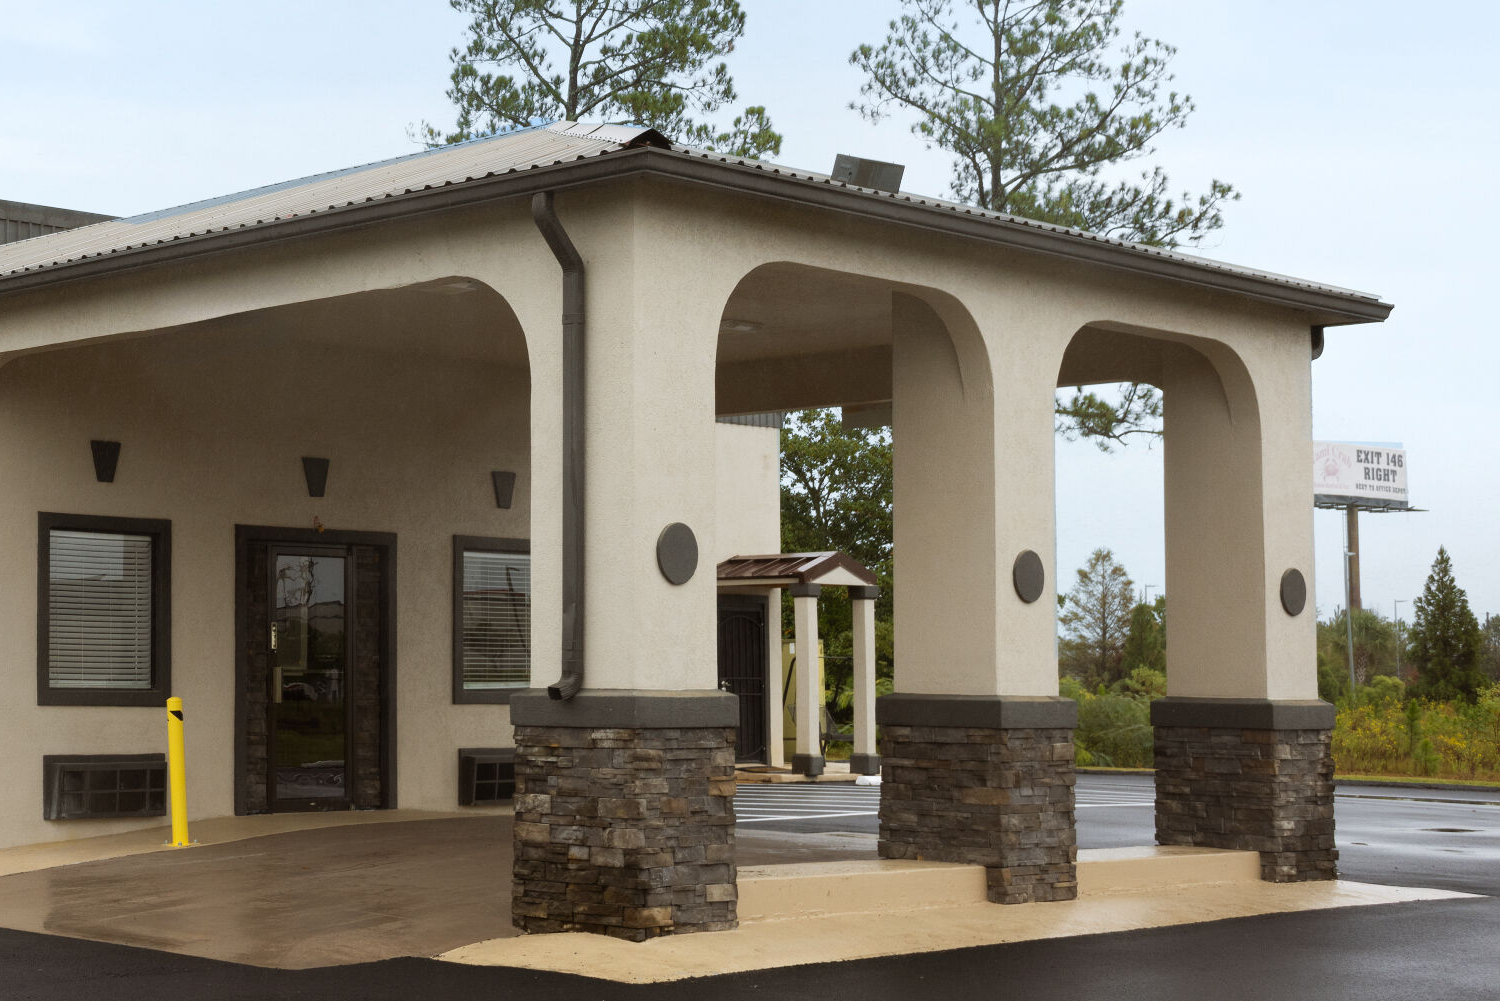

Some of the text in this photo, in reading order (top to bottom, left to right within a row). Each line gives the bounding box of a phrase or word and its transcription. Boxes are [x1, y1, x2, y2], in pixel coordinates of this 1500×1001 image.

[1356, 449, 1404, 468] EXIT 146
[1364, 466, 1397, 483] RIGHT
[1392, 487, 1406, 495] DEPOT
